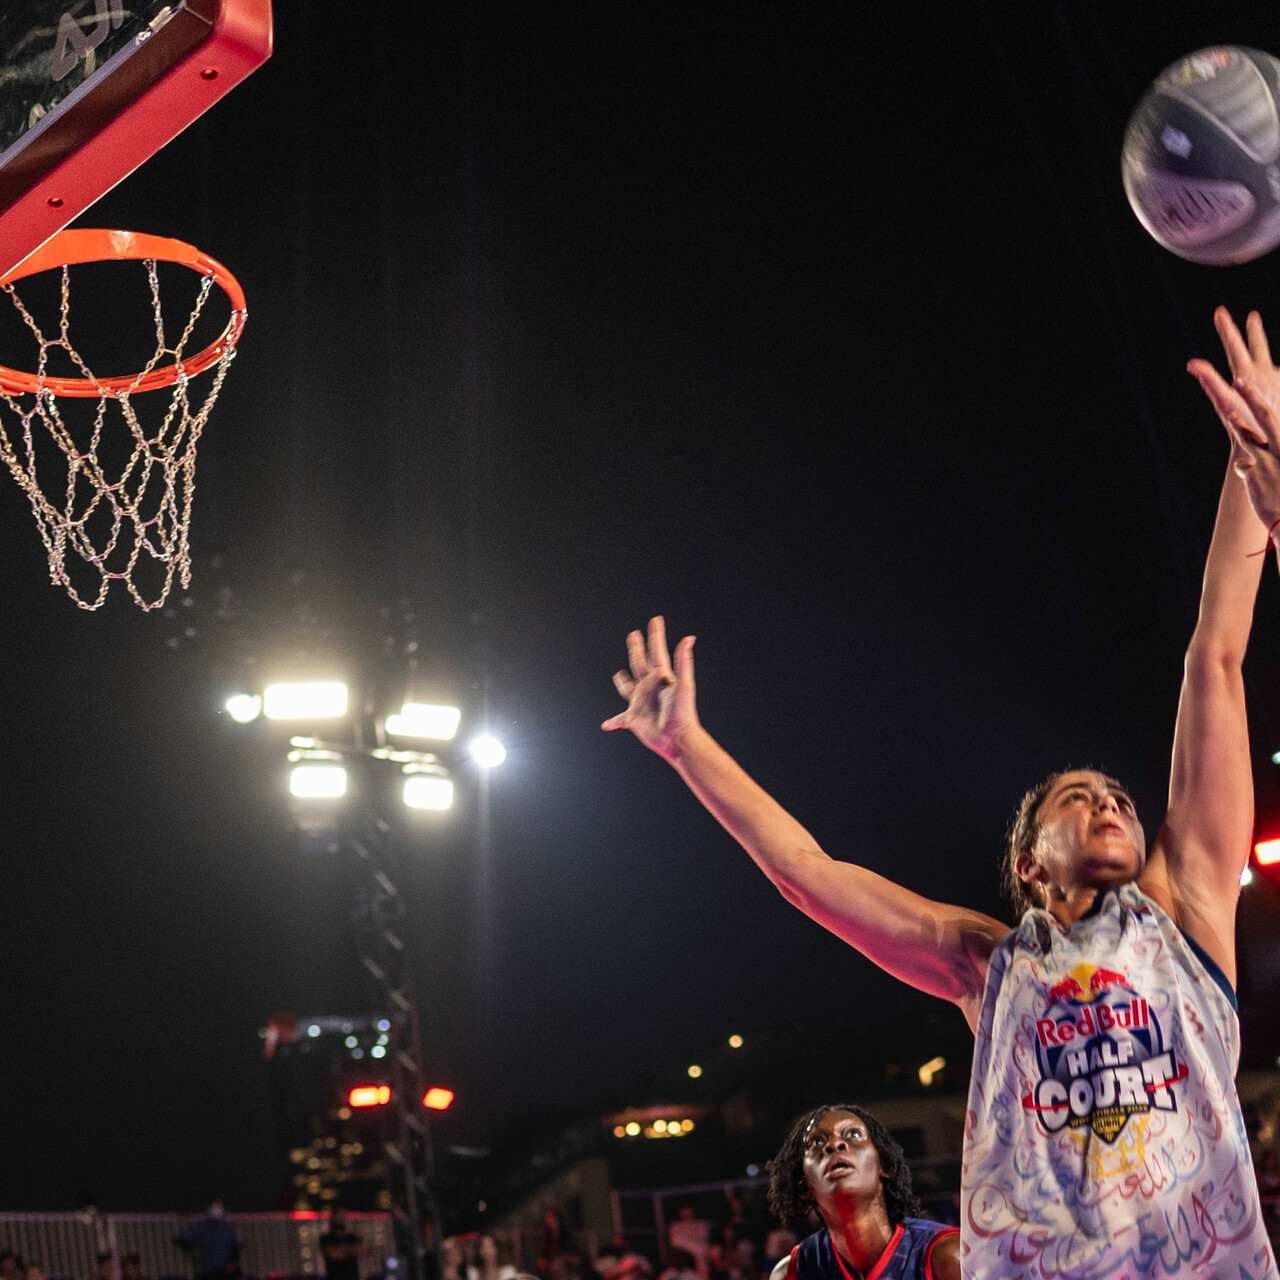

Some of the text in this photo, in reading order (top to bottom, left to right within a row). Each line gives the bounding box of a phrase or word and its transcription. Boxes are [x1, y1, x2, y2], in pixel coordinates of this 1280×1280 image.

[1036, 997, 1150, 1048] Red Bull
[1066, 1040, 1135, 1078] HALF
[1038, 1052, 1175, 1132] COURT
